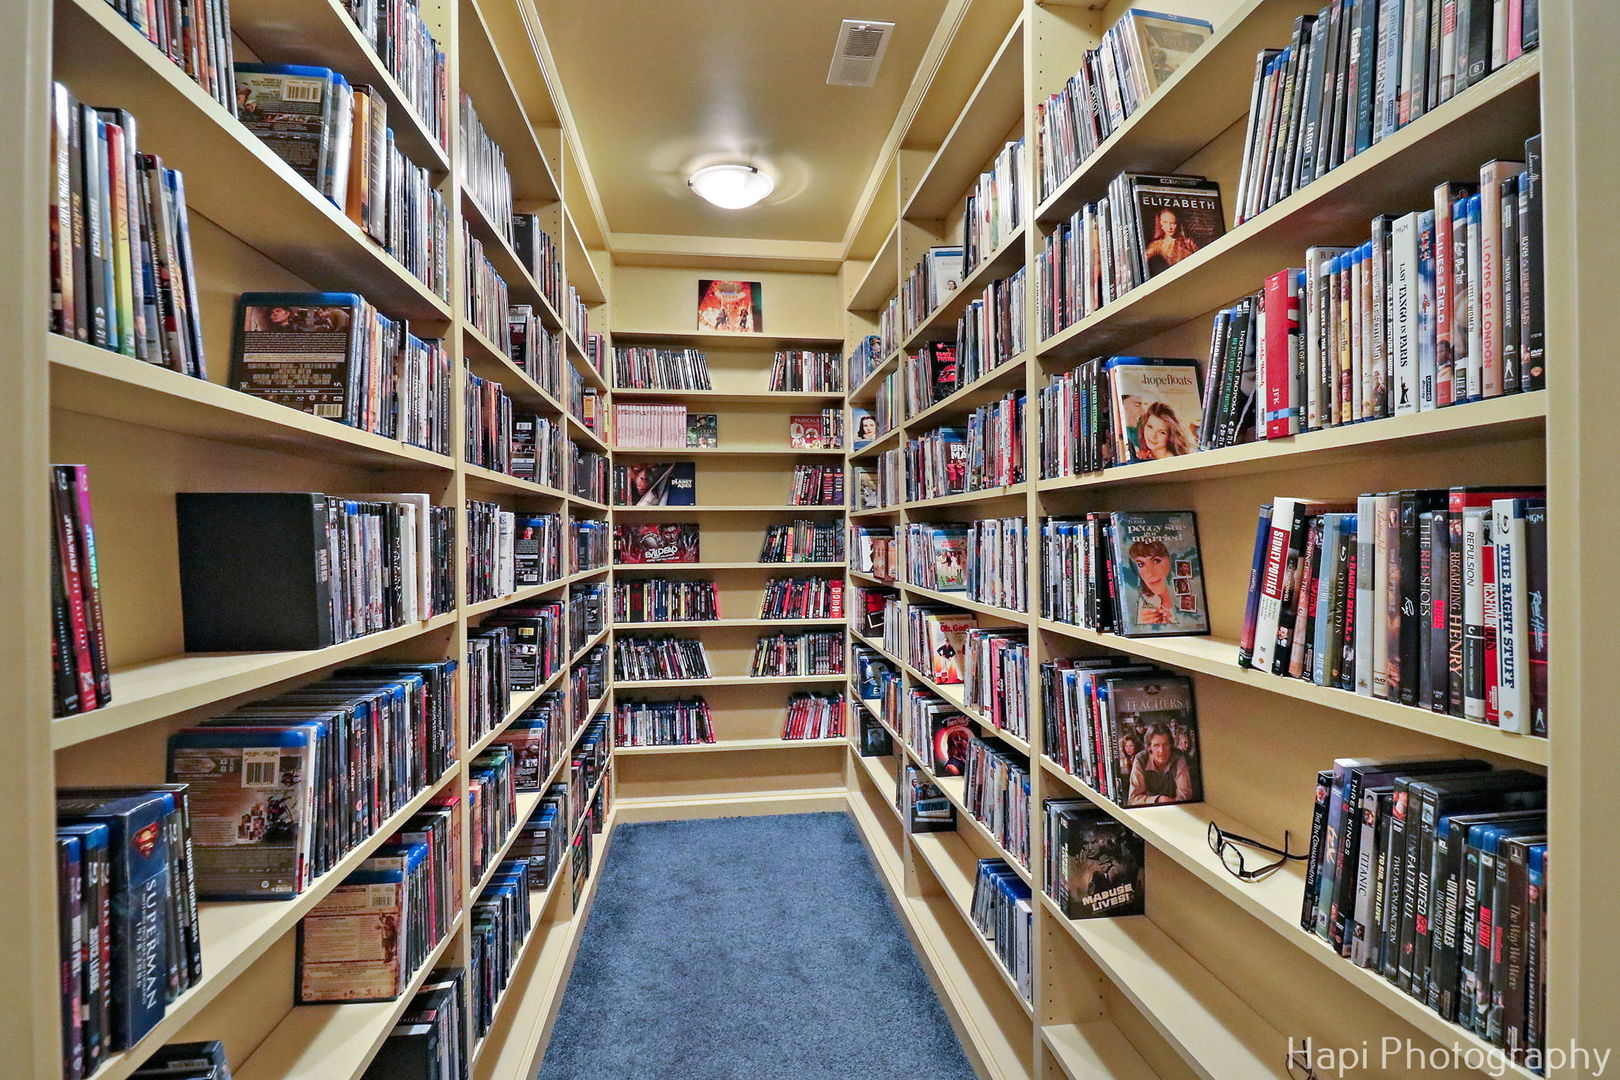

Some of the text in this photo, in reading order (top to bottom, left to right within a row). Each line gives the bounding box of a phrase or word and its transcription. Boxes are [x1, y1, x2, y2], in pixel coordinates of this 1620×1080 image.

[1388, 33, 1397, 57] Gump
[1359, 25, 1371, 130] FLATLINERS
[1305, 121, 1315, 153] FARGO
[72, 192, 82, 249] SEARCHERS
[1142, 196, 1215, 210] ELIZABETH
[1396, 223, 1408, 234] MGM
[1436, 232, 1444, 273] LILIES
[1399, 285, 1407, 323] TANGO
[1483, 238, 1492, 369] LLOYDS OF LONDON
[1321, 328, 1326, 337] OF
[1400, 325, 1406, 333] IN
[1299, 351, 1304, 360] OF
[1400, 336, 1408, 367] PARIS
[1230, 331, 1245, 416] INDECENT PROPOSAL
[1128, 525, 1161, 533] peggy
[1420, 522, 1430, 548] THE
[1526, 512, 1544, 522] MGM
[67, 542, 77, 573] WARS
[1132, 534, 1183, 544] married
[87, 552, 98, 589] WARS
[320, 549, 328, 582] MIB
[1265, 530, 1284, 595] SIDNEY POITIER
[1299, 541, 1312, 603] PRINCE TIDES
[1466, 531, 1475, 587] REPULSION
[1345, 562, 1355, 634] RAGING BULL
[1402, 596, 1414, 616] Ray
[1420, 576, 1431, 616] SHOES
[1484, 583, 1497, 628] RESERVOIR
[1334, 601, 1344, 634] VADIS
[1449, 551, 1463, 679] REGARDING HENRY
[1500, 544, 1514, 689] THE RIGHT STUFF
[1535, 618, 1545, 653] House
[1127, 698, 1183, 711] TEACHERS
[1349, 779, 1358, 813] THREE
[1315, 811, 1323, 823] THE
[1344, 819, 1353, 856] KINGS
[1307, 835, 1320, 885] COMMANDMENTS
[1358, 851, 1370, 896] TITANIC
[184, 838, 198, 943] WONDER WOMAN 1984
[1081, 884, 1133, 906] MABUSE
[1092, 895, 1130, 912] LIVES!
[1389, 855, 1401, 944] TWO MOON JUNCTION
[1418, 872, 1428, 914] UNITED
[1433, 890, 1445, 951] UNTAMED HEART
[1443, 880, 1458, 948] UNTOUCHABLES
[1463, 879, 1476, 956] UP IN THE AIR
[145, 879, 157, 1010] SUPERMAN
[1508, 904, 1520, 990] The Way We Were
